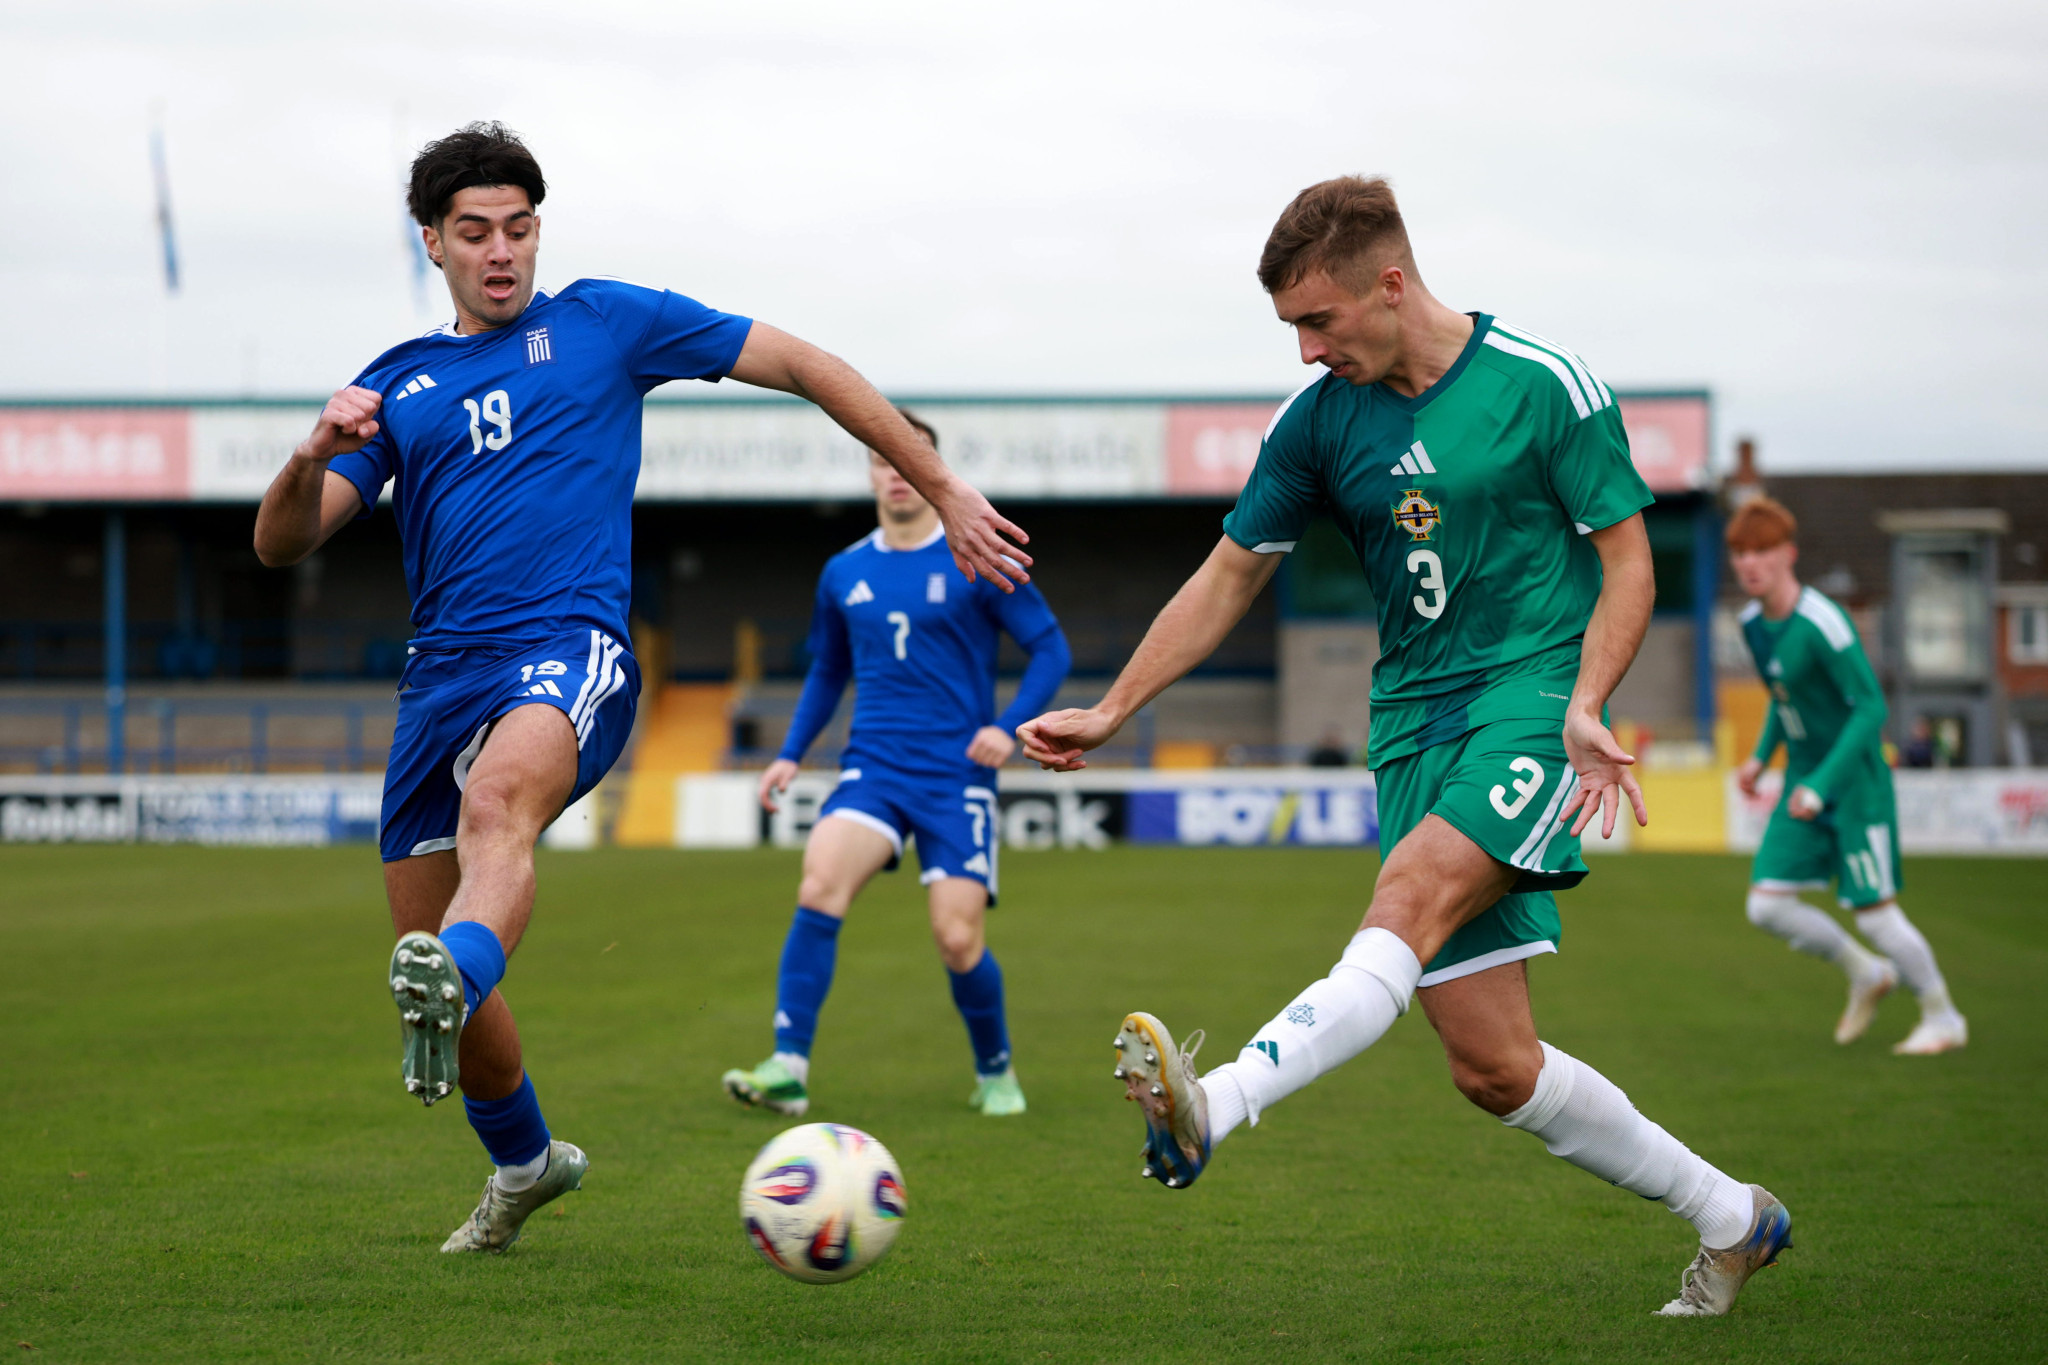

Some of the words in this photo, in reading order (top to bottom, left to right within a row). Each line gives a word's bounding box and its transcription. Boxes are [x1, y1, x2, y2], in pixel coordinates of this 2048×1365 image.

[463, 389, 512, 455] 19
[1407, 549, 1446, 619] 3
[887, 611, 910, 660] 7
[521, 660, 568, 683] 19
[1178, 788, 1377, 843] BOYLE
[1489, 756, 1545, 820] 3
[963, 802, 985, 848] 7
